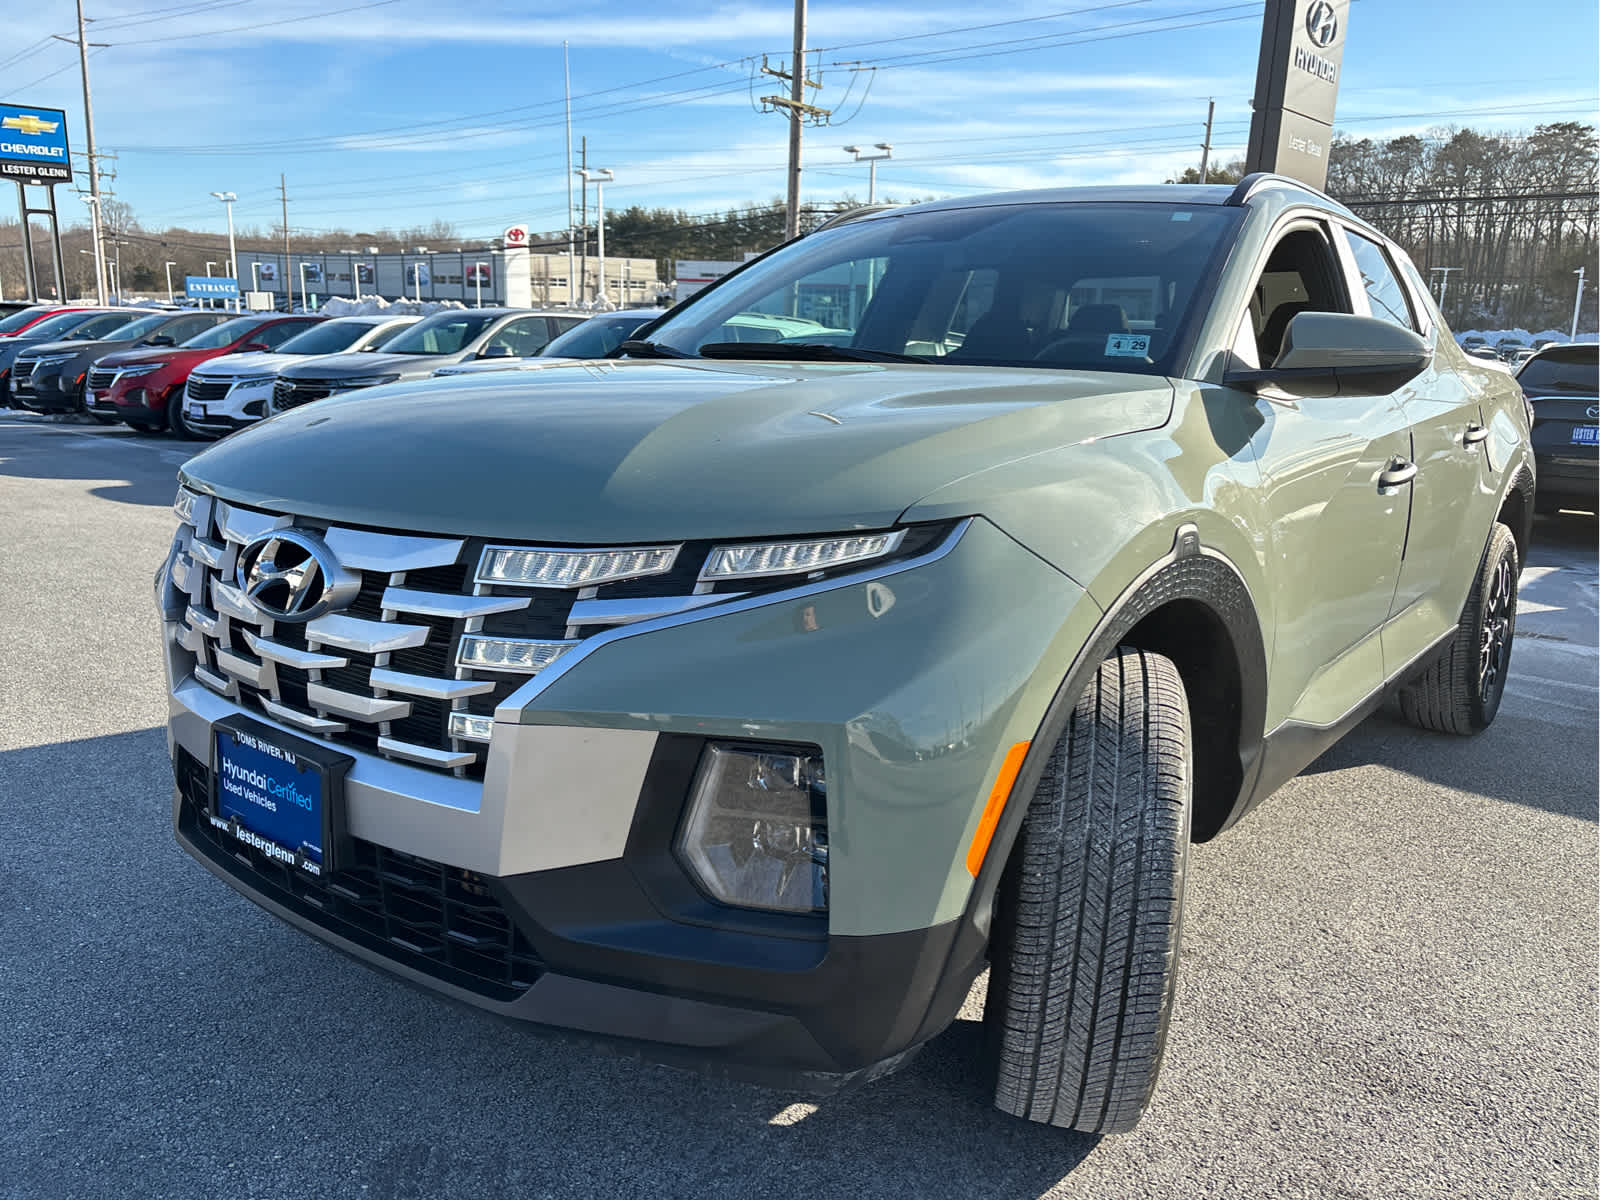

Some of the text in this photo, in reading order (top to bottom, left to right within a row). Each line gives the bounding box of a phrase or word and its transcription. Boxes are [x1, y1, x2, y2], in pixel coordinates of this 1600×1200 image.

[1294, 45, 1337, 84] HYUNDAI
[0, 142, 65, 157] CHEVROLET
[2, 164, 68, 178] LESTER GLENN
[190, 283, 236, 293] ENTRANCE
[1112, 340, 1146, 350] 4 29
[1572, 427, 1595, 440] LESTER
[236, 731, 257, 749] TOMS
[284, 750, 296, 765] NJ
[222, 756, 313, 812] Hyundai Certified
[223, 778, 277, 812] Used Vehicles
[210, 816, 230, 832] www.
[236, 825, 296, 865] lesterglenn
